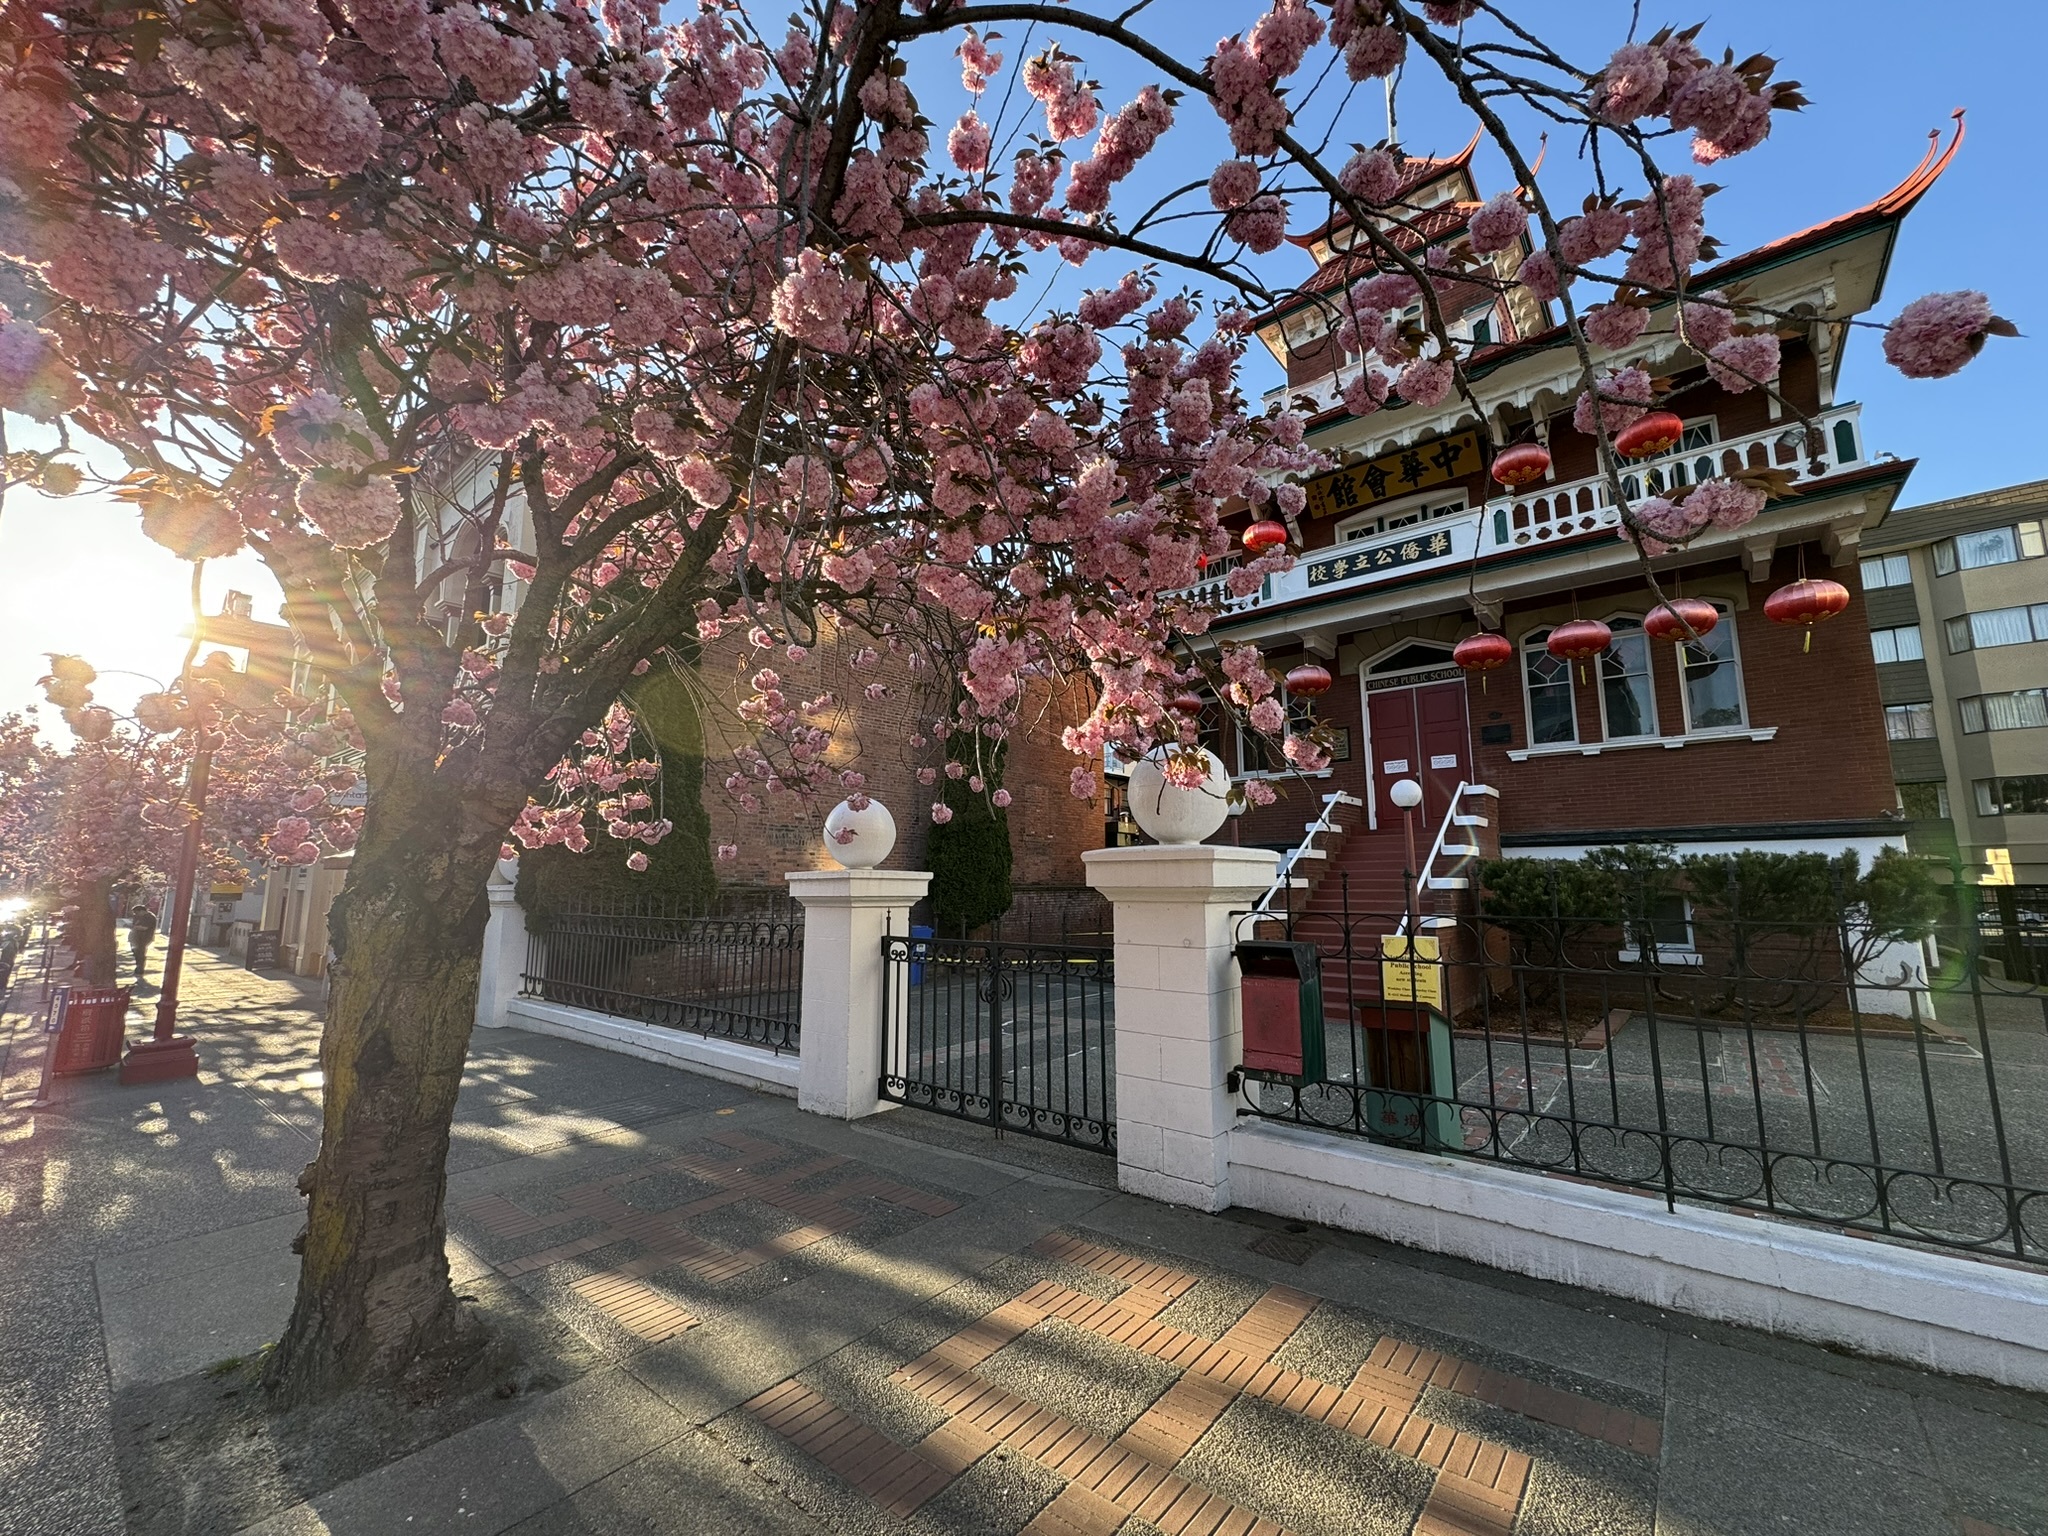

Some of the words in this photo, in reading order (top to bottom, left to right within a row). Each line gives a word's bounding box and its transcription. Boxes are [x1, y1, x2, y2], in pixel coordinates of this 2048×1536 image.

[1328, 442, 1464, 508] 中華會館
[1309, 532, 1449, 582] 華僑公立學校
[1367, 678, 1399, 690] CHINESE
[1400, 674, 1429, 685] PUBLIC
[1430, 668, 1464, 681] SCHOOL
